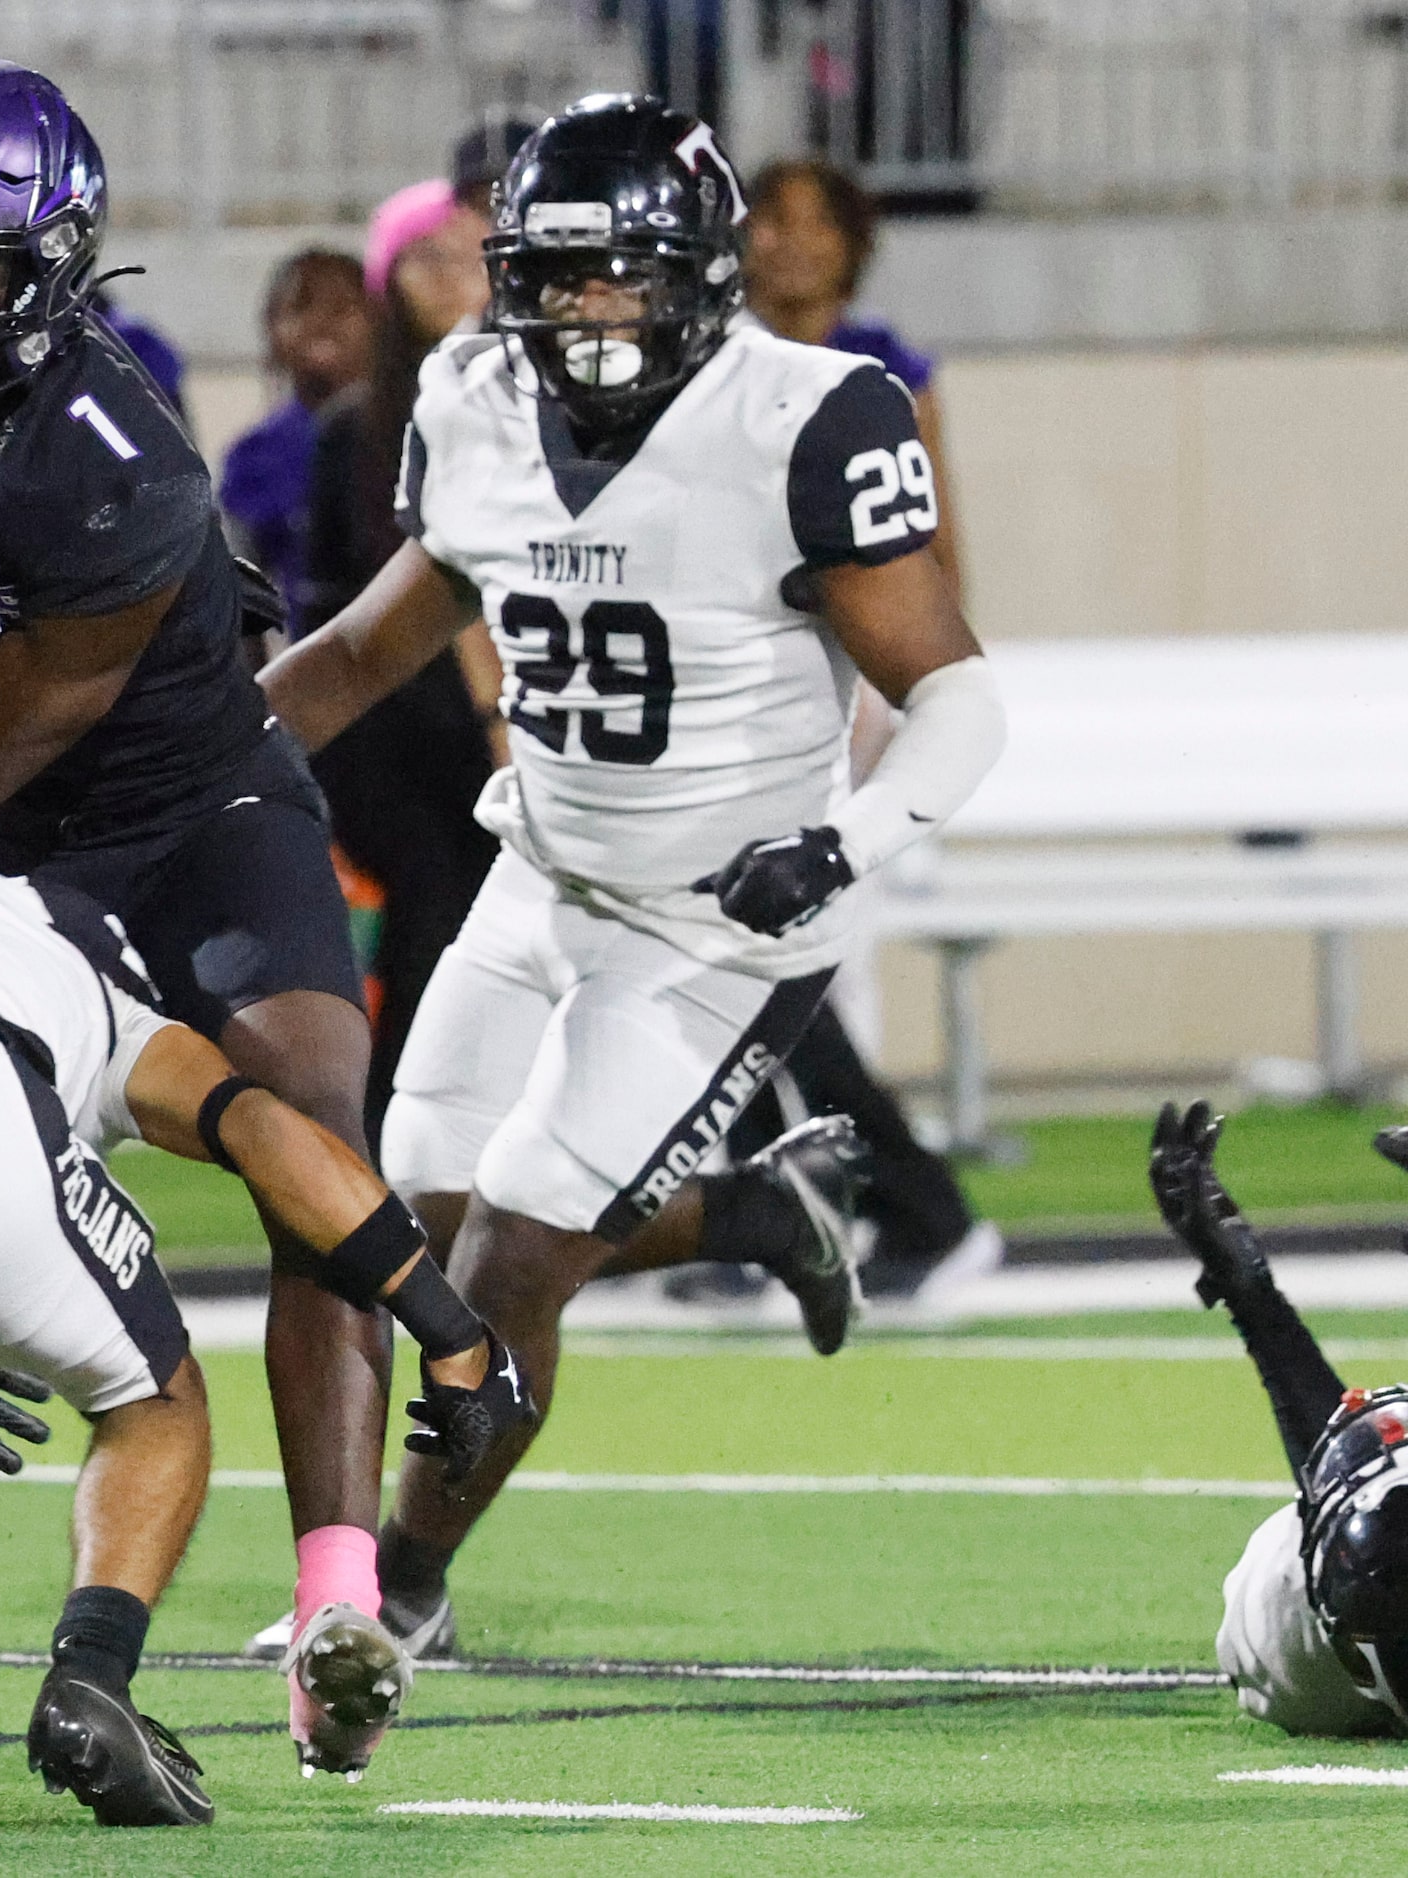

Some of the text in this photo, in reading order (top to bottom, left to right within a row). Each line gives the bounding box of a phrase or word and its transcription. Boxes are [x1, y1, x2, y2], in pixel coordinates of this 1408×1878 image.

[65, 391, 144, 462] 1
[844, 438, 939, 548] 29
[528, 540, 627, 585] TRINITY
[500, 591, 676, 766] 29
[630, 1041, 780, 1220] TROJANS
